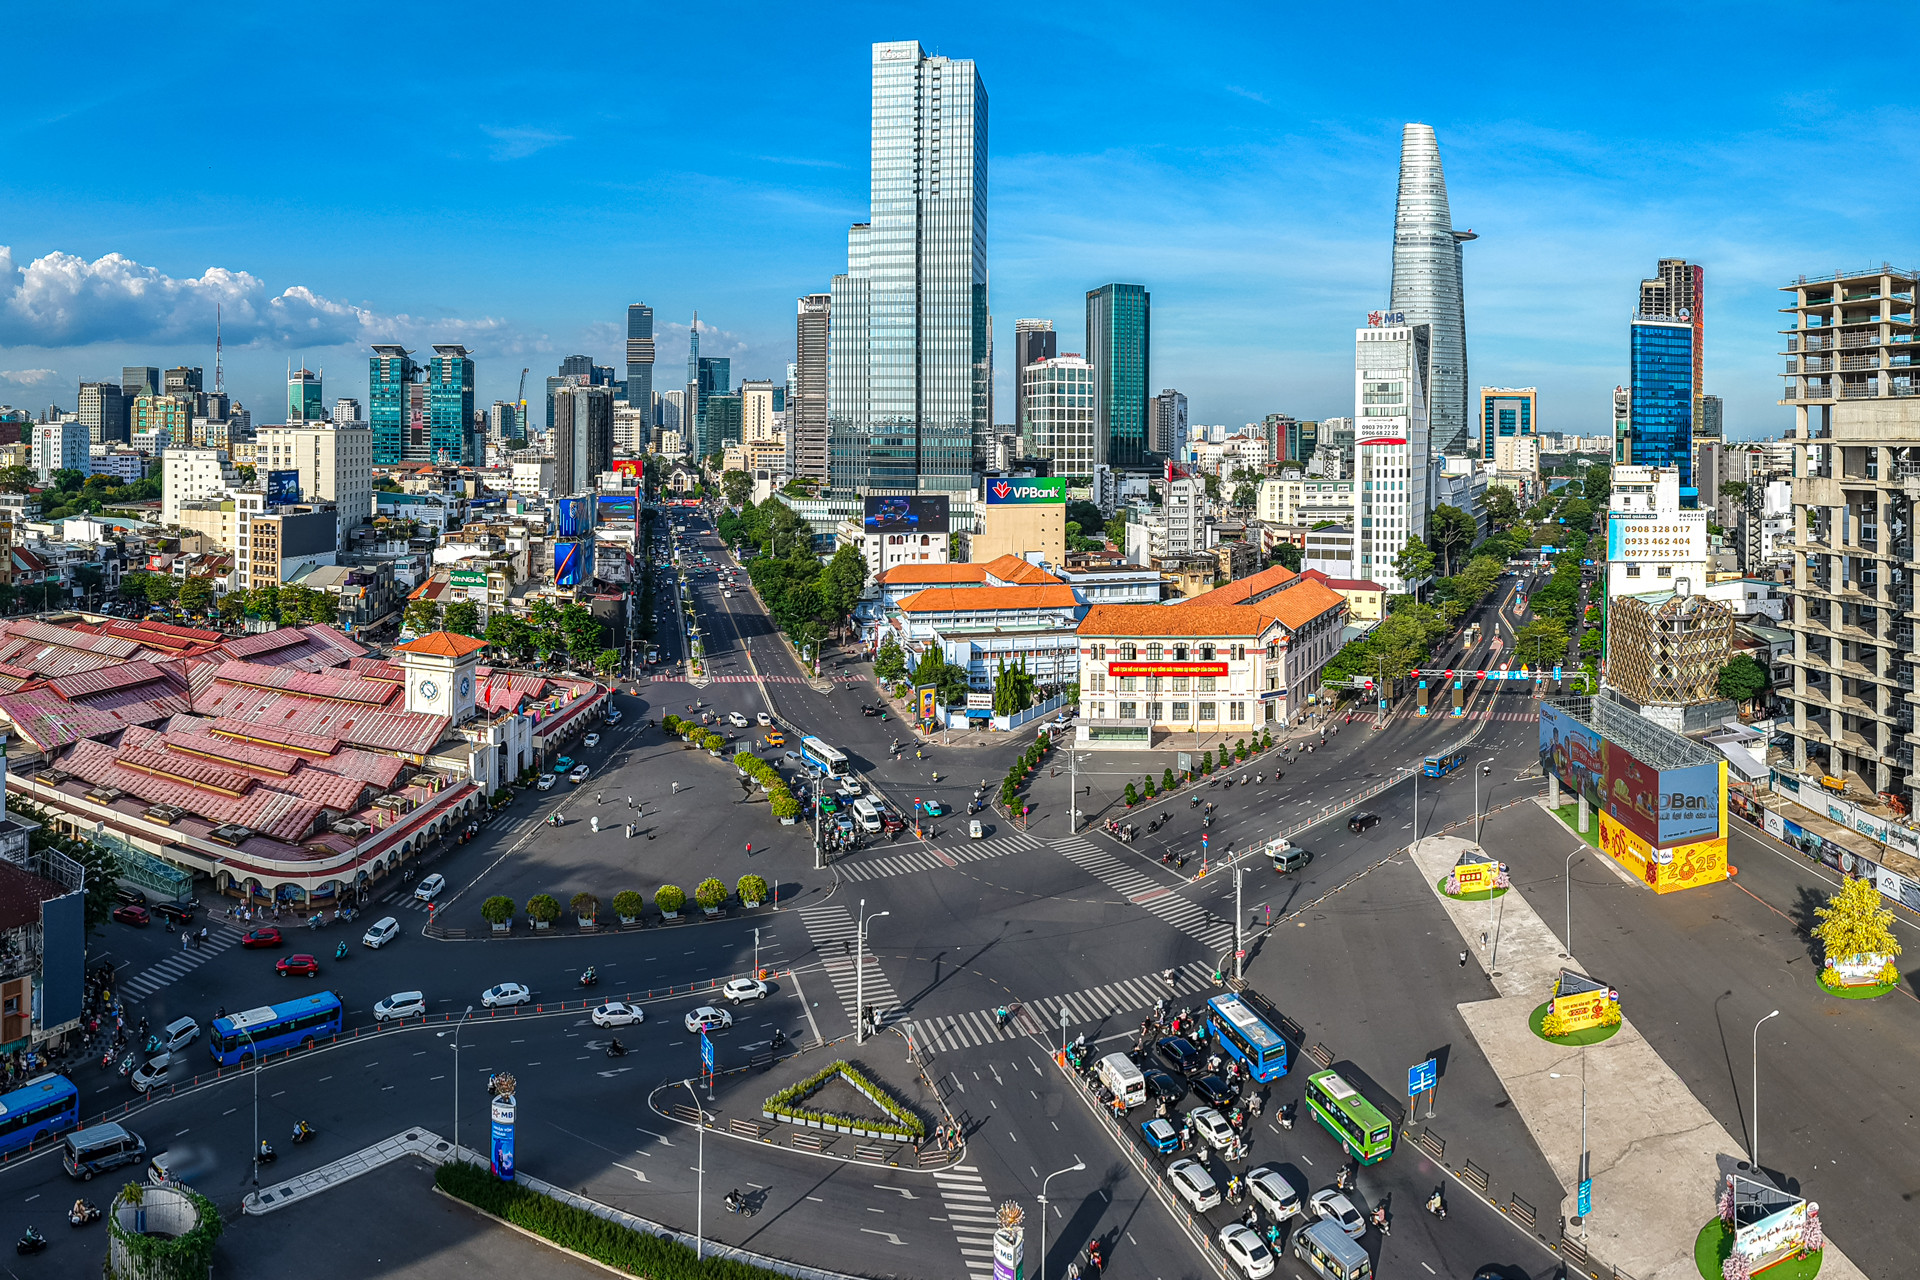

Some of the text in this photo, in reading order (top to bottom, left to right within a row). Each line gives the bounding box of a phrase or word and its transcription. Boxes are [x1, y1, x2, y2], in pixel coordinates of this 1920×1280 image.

[1384, 312, 1405, 324] MB
[1012, 486, 1060, 499] VPBank
[1625, 525, 1690, 533] 0908 328 017
[1625, 537, 1690, 545] 0933 462 404
[1625, 549, 1690, 557] 0977 755 751
[501, 1111, 513, 1119] MB
[1000, 1249, 1013, 1261] MB
